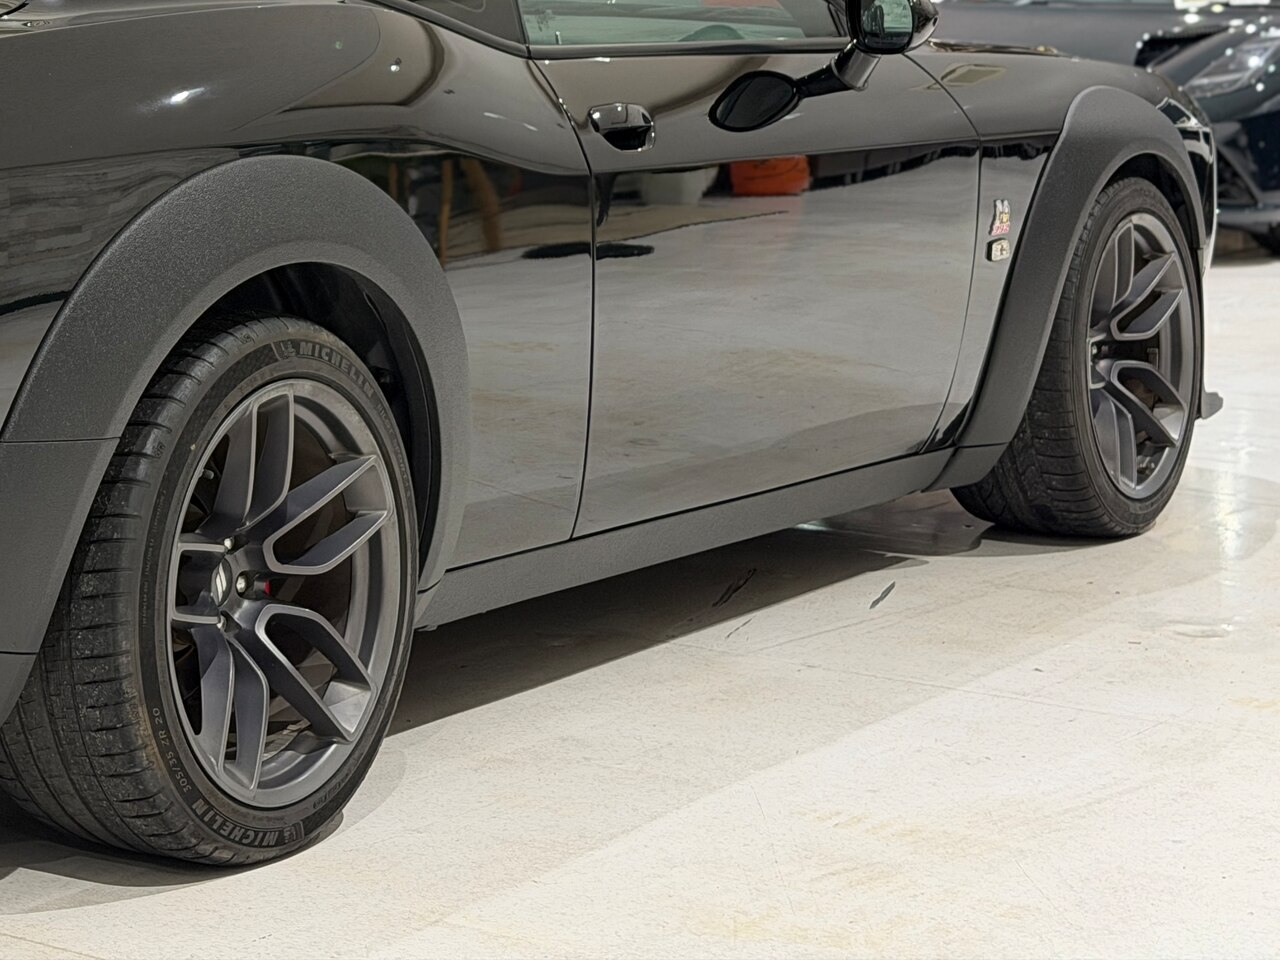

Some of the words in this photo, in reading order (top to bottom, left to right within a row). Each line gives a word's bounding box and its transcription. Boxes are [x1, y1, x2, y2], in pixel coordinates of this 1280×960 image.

[300, 341, 375, 398] MICHELIN
[152, 707, 163, 724] 20
[158, 730, 169, 746] ZR
[165, 751, 192, 793] 305/35
[191, 799, 279, 846] MICHELIN
